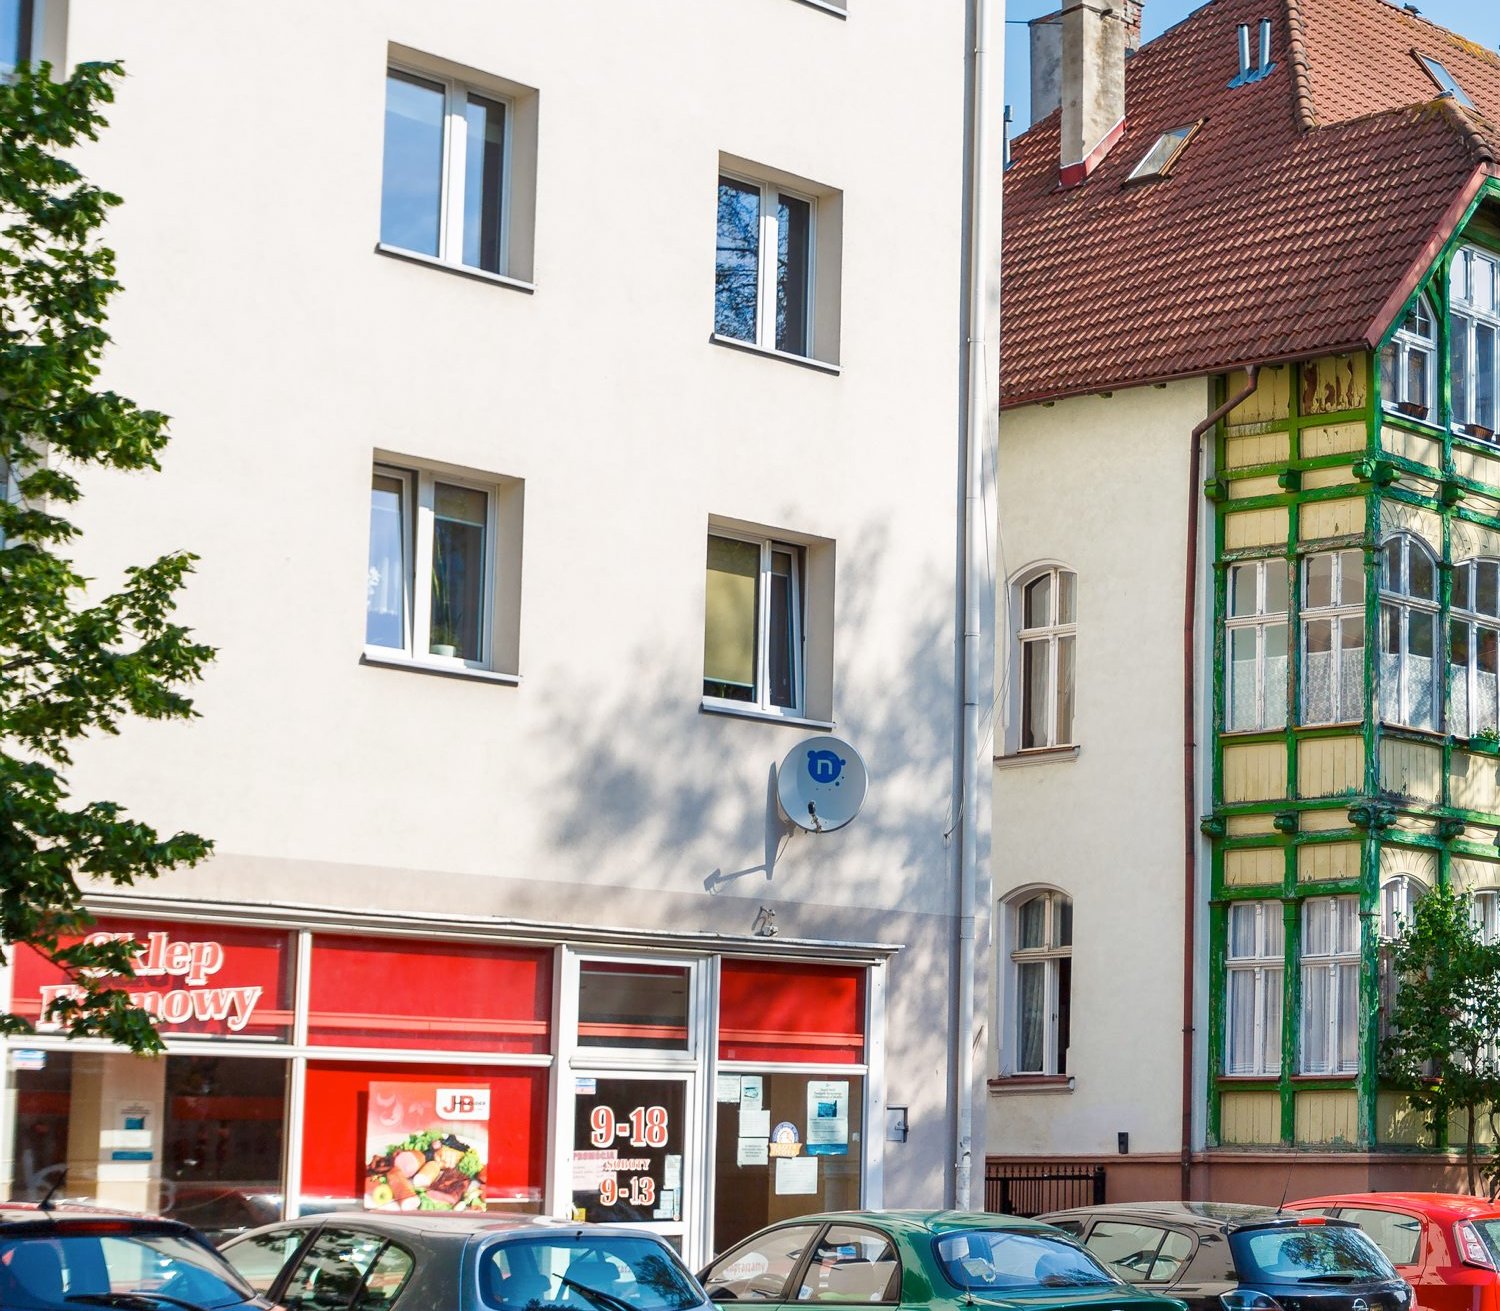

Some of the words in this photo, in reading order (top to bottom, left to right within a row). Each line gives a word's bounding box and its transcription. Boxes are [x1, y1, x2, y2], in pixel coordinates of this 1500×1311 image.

[817, 759, 833, 775] n
[35, 984, 262, 1031] Fmowy
[590, 1105, 668, 1148] 9-18
[602, 1158, 651, 1171] SOBOTY
[600, 1176, 656, 1206] 9-13
